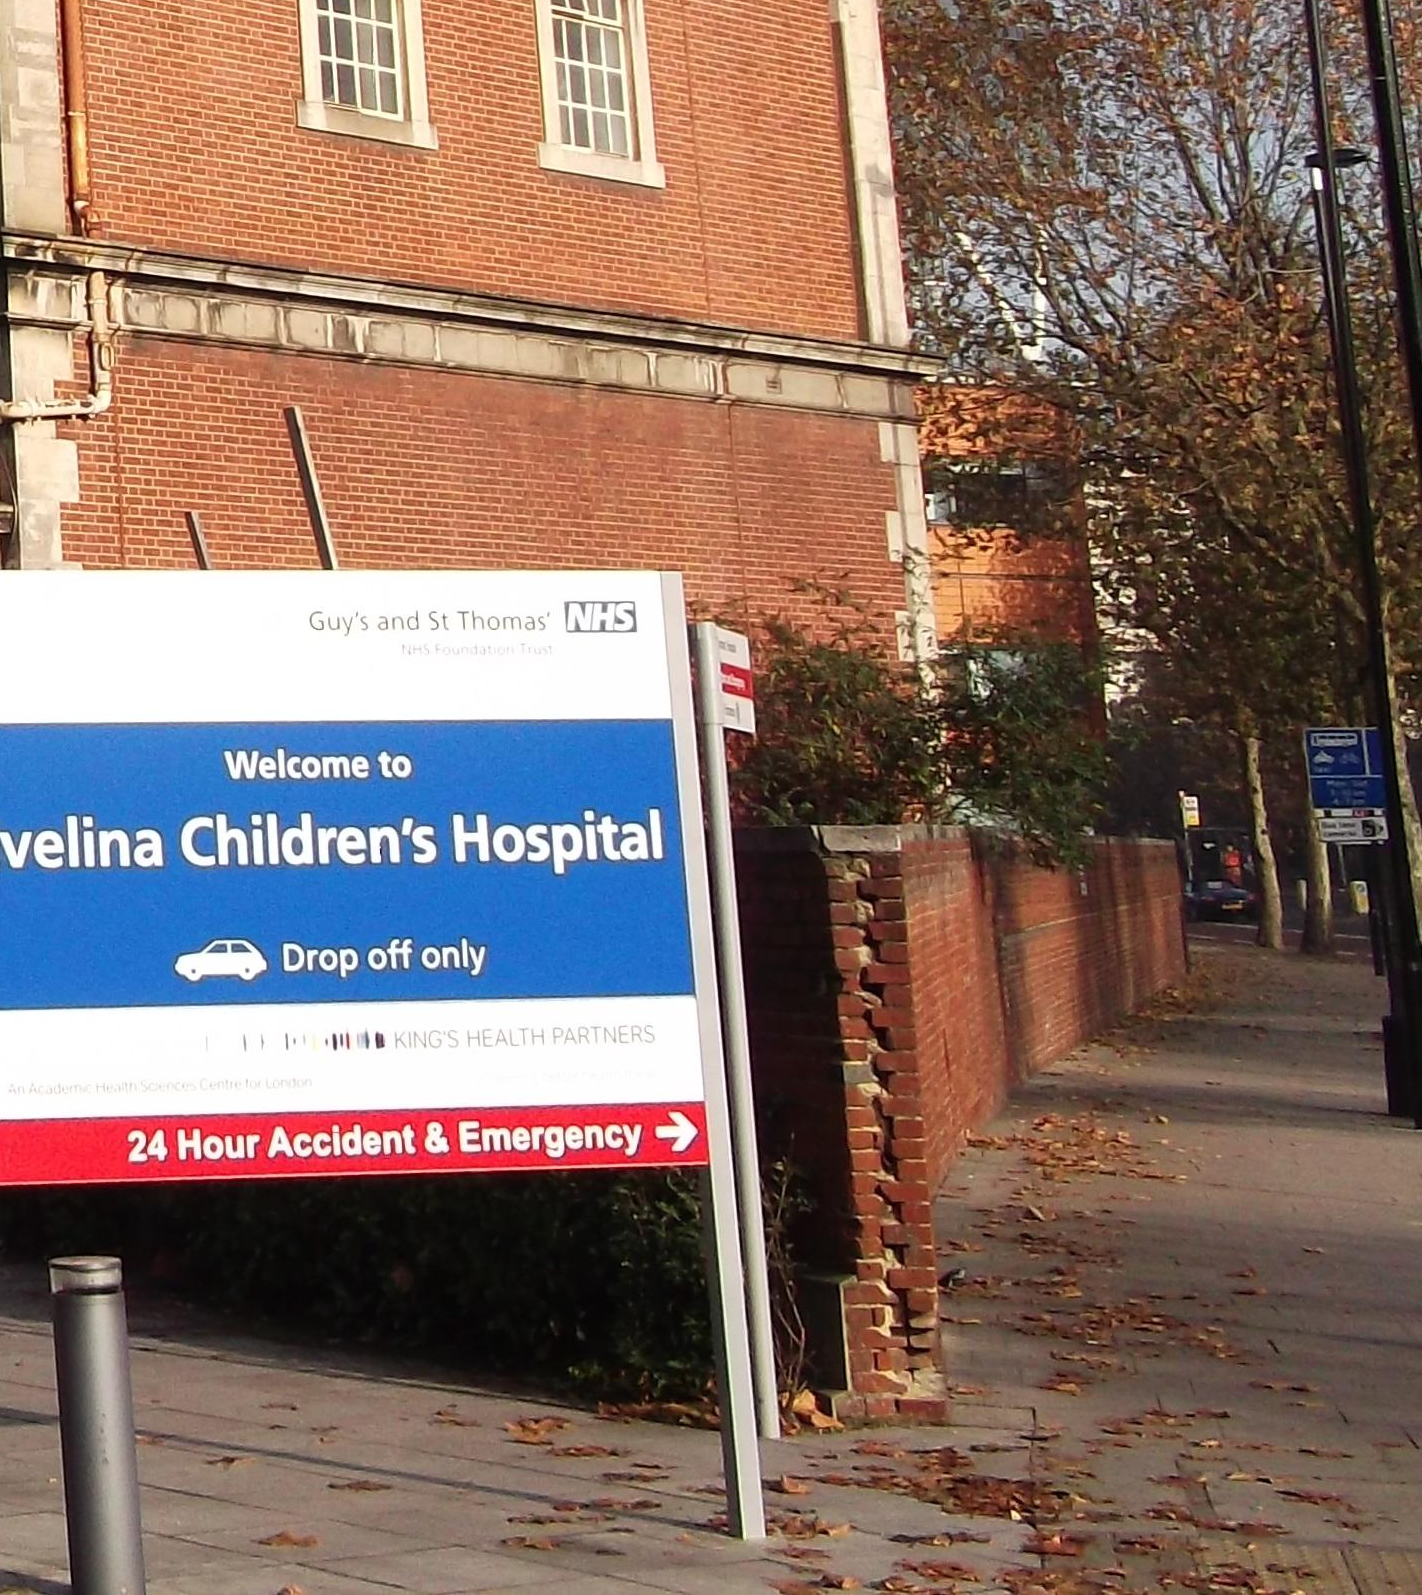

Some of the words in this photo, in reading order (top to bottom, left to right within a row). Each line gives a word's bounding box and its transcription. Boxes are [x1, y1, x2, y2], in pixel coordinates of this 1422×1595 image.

[308, 610, 369, 636] Guy's
[377, 610, 421, 632] and
[428, 610, 450, 632] St
[456, 609, 552, 632] Thomas'
[564, 601, 638, 632] NHS
[223, 748, 370, 780] Welcome
[377, 751, 412, 779] to
[180, 812, 438, 867] Children's
[452, 808, 664, 875] Hospital
[282, 942, 359, 978] Drop
[367, 938, 414, 970] off
[420, 937, 487, 977] only
[393, 1029, 459, 1049] KING'S
[466, 1027, 545, 1048] HEALTH
[552, 1024, 656, 1046] PARTNERS
[96, 1081, 138, 1094] Health
[127, 1129, 168, 1162] 24
[177, 1128, 260, 1161] Hour
[267, 1124, 416, 1159] Accident
[424, 1121, 450, 1155] &
[458, 1120, 643, 1158] Emergency
